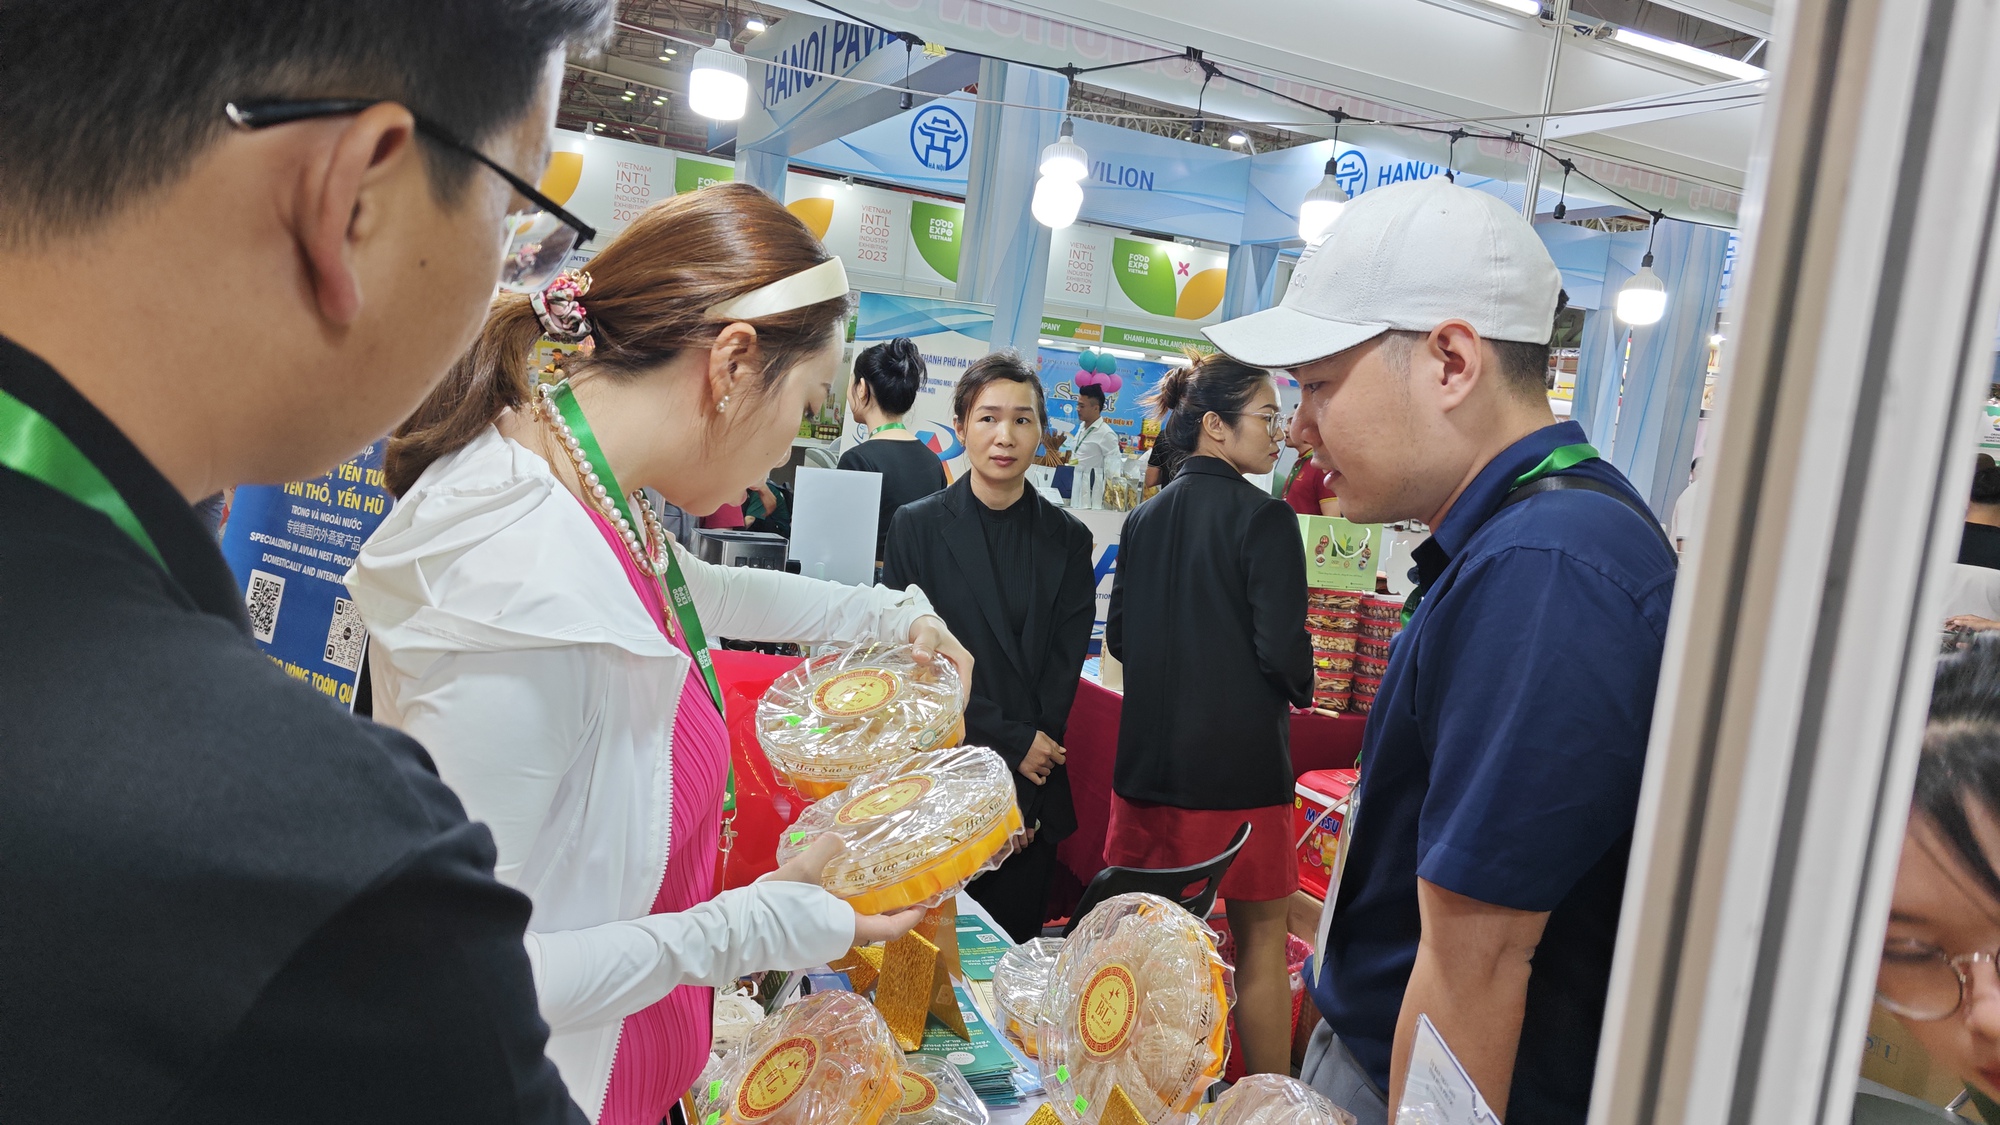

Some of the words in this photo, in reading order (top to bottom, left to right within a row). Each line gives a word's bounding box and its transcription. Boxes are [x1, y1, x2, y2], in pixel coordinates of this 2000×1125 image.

[763, 25, 826, 110] HANOI
[616, 161, 652, 173] VIETNAM
[616, 170, 650, 187] INT'L
[615, 183, 650, 197] FOOD
[614, 194, 649, 205] INDUSTRY
[861, 205, 891, 215] VIETNAM
[861, 213, 890, 228] INT'L
[930, 218, 954, 229] FOOD
[860, 225, 889, 237] FOOD
[929, 226, 953, 237] EXPO
[859, 236, 888, 245] INDUSTRY
[929, 234, 952, 242] VIETNAM
[858, 242, 888, 251] EXHIBITION
[1070, 242, 1096, 250] VIETNAM
[857, 249, 887, 263] 2023
[1069, 249, 1094, 262] INT'L
[1129, 253, 1150, 263] FOOD
[1068, 260, 1094, 272] FOOD
[1128, 261, 1149, 270] EXPO
[1067, 269, 1092, 278] INDUSTRY
[1128, 268, 1148, 276] VIETNAM
[1065, 282, 1091, 295] 2023
[1123, 333, 1145, 344] KHANH
[1145, 336, 1158, 346] HOA
[338, 459, 362, 483] YẾN
[305, 482, 332, 507] THÔ,
[337, 486, 361, 510] YẾN
[291, 505, 310, 518] TRONG
[311, 508, 320, 520] VÀ
[320, 512, 341, 526] NGOÀI
[342, 517, 363, 531] NƯỚC
[249, 531, 292, 552] SPECIALIZING
[291, 544, 299, 553] IN
[299, 545, 317, 558] AVIAN
[319, 551, 333, 563] NEST
[262, 553, 303, 573] DOMESTICALLY
[302, 565, 316, 578] AND
